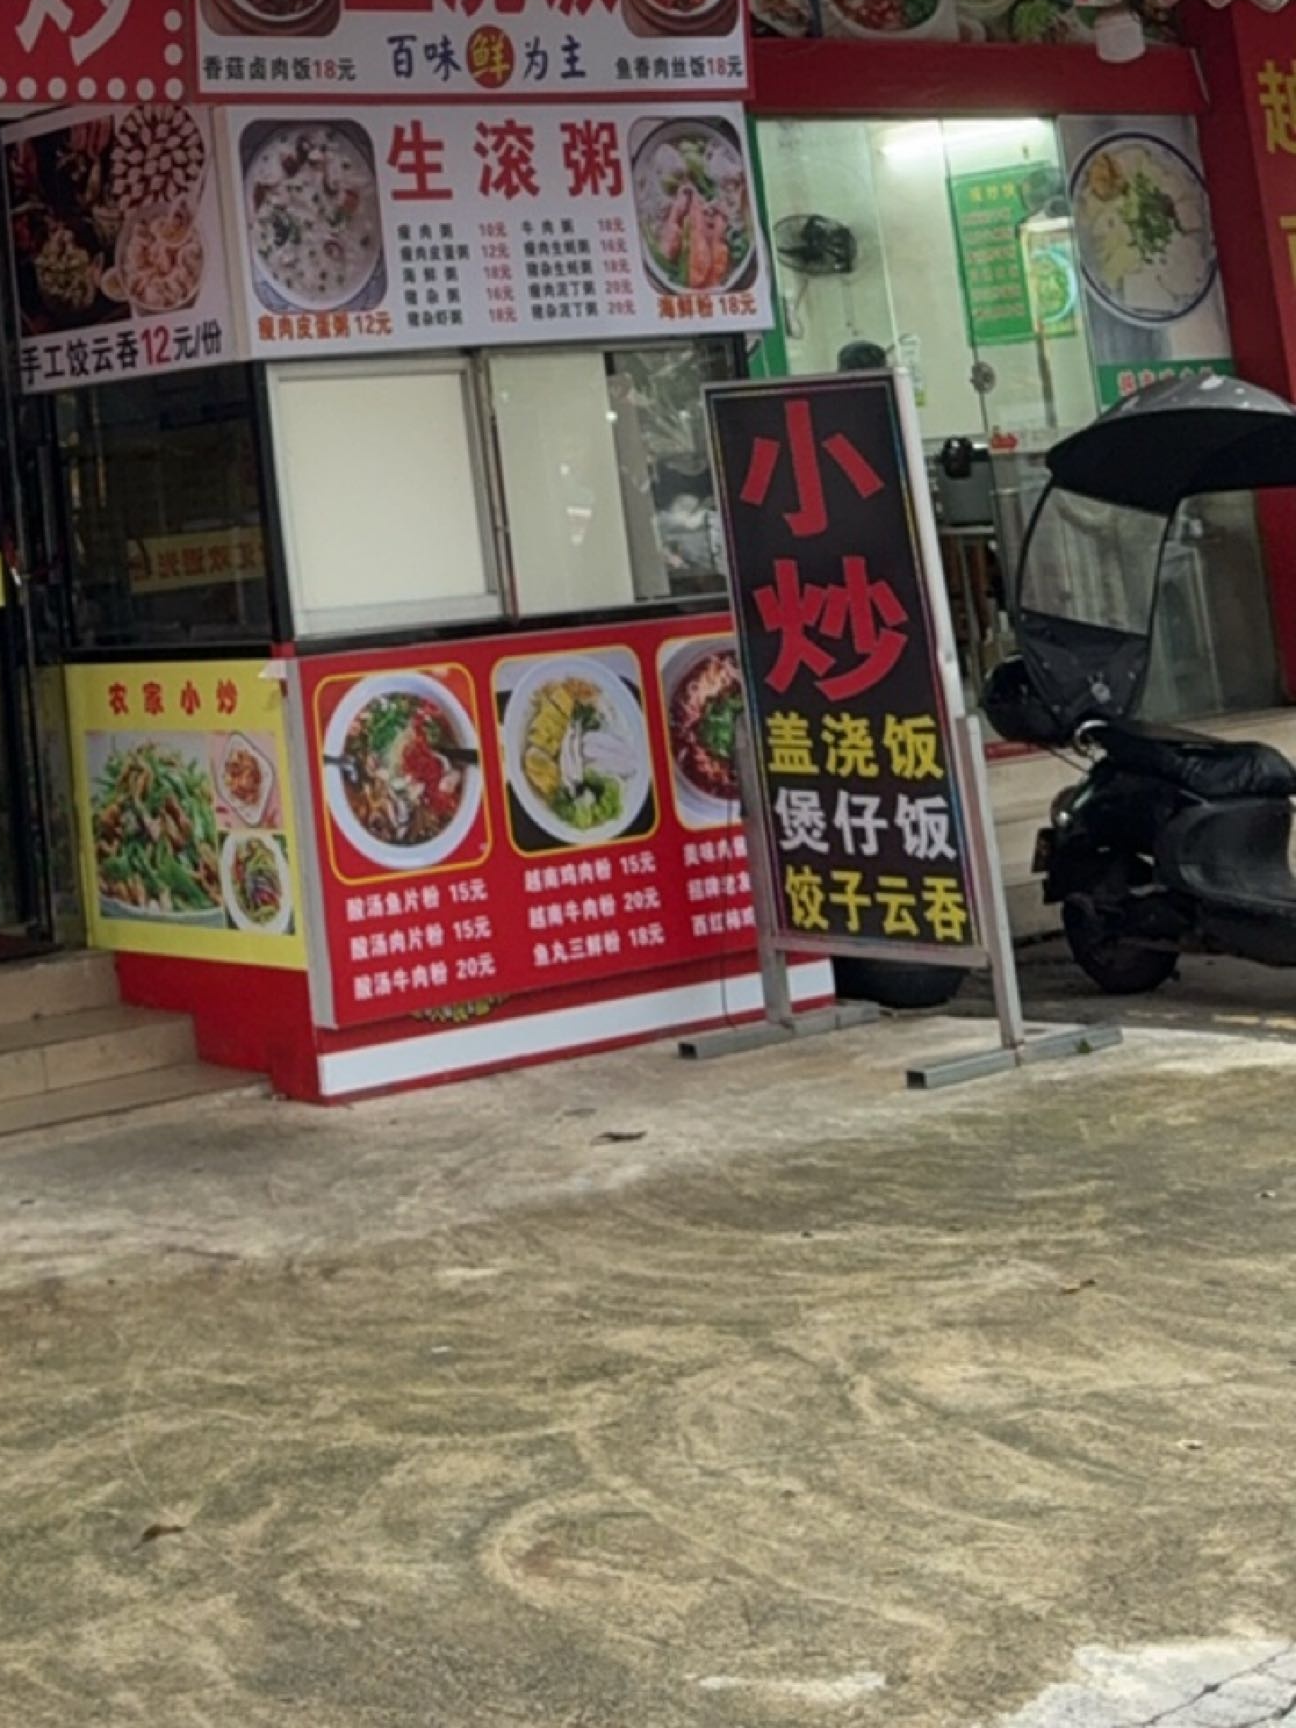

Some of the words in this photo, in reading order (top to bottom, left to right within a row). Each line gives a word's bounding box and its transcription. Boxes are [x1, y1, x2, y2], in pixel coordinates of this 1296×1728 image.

[387, 33, 588, 82] 百味鲜为主
[387, 120, 624, 201] 生滚粥
[354, 311, 393, 335] 12元
[718, 293, 757, 316] 18元
[740, 399, 908, 702] 小炒
[108, 679, 239, 717] 农家小炒
[766, 711, 944, 779] 盖浇饭
[775, 786, 957, 861] 煲仔饭
[524, 858, 611, 893] 越南鸡肉粉
[619, 851, 657, 876] 15元
[345, 885, 440, 922] 酸汤鱼片粉
[448, 878, 488, 904] 15元
[528, 893, 616, 930] 越南牛肉粉
[623, 887, 662, 912] 20元
[785, 865, 967, 943] 饺子云吞
[350, 922, 444, 961] 酸汤肉片粉
[452, 915, 492, 941] 15元
[533, 930, 621, 967] 鱼丸三鲜粉
[628, 922, 666, 948] 18元
[353, 961, 448, 1001] 酸汤牛肉粉
[455, 952, 496, 980] 20元
